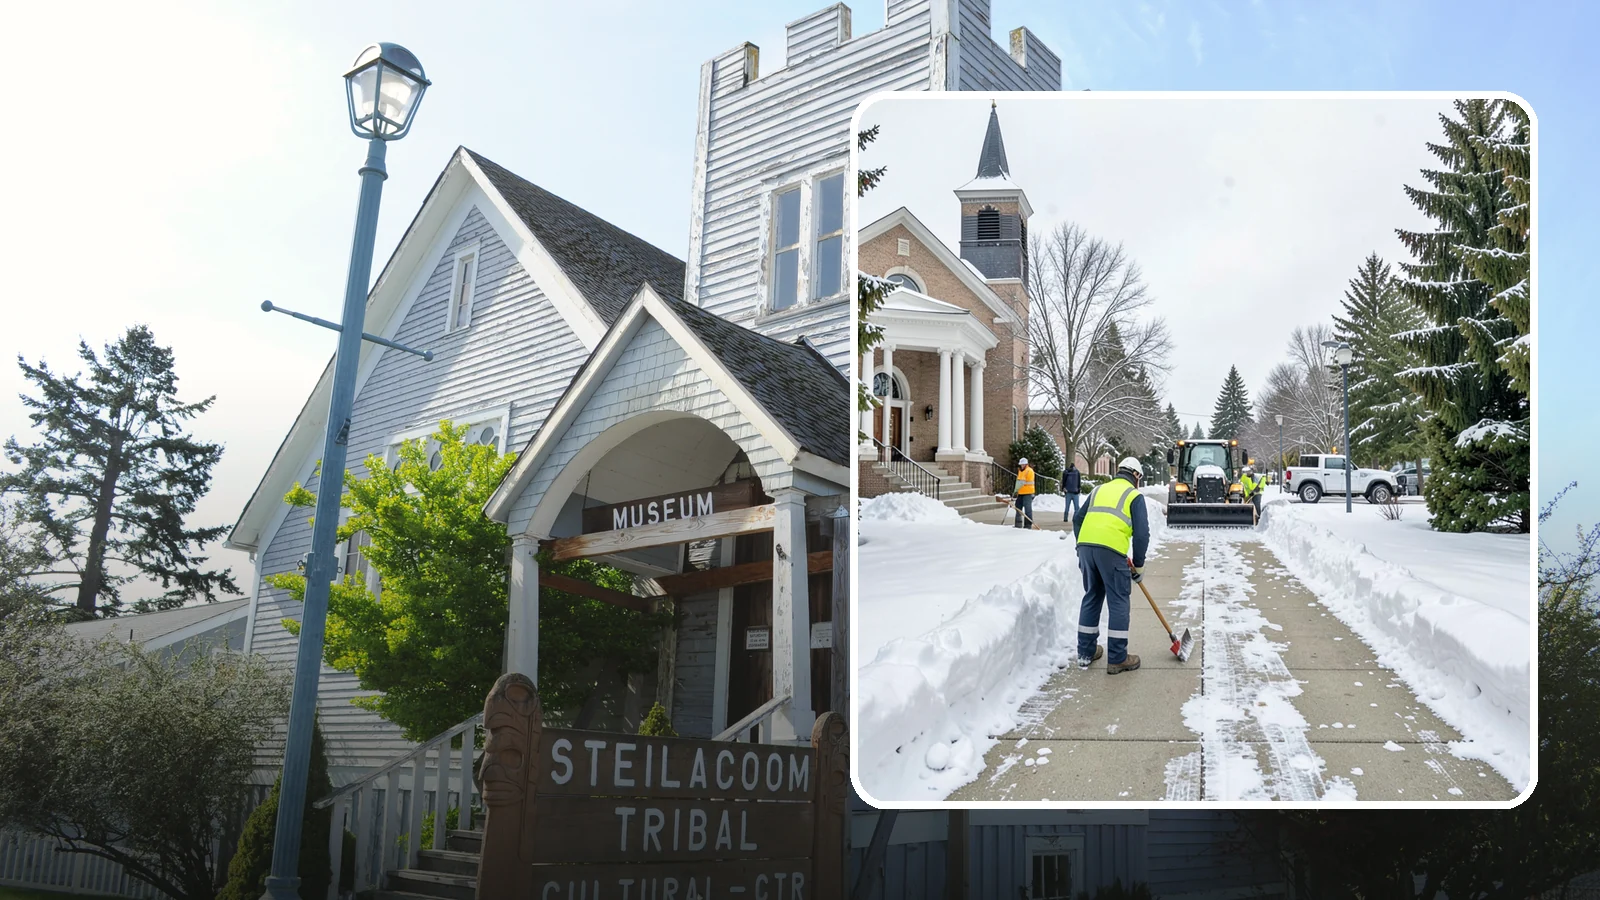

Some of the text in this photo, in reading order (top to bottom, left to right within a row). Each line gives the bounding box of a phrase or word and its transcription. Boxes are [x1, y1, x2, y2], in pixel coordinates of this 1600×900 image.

[613, 492, 713, 530] MUSEUM
[551, 738, 809, 791] STEILACOOM
[615, 807, 757, 851] TRIBAL
